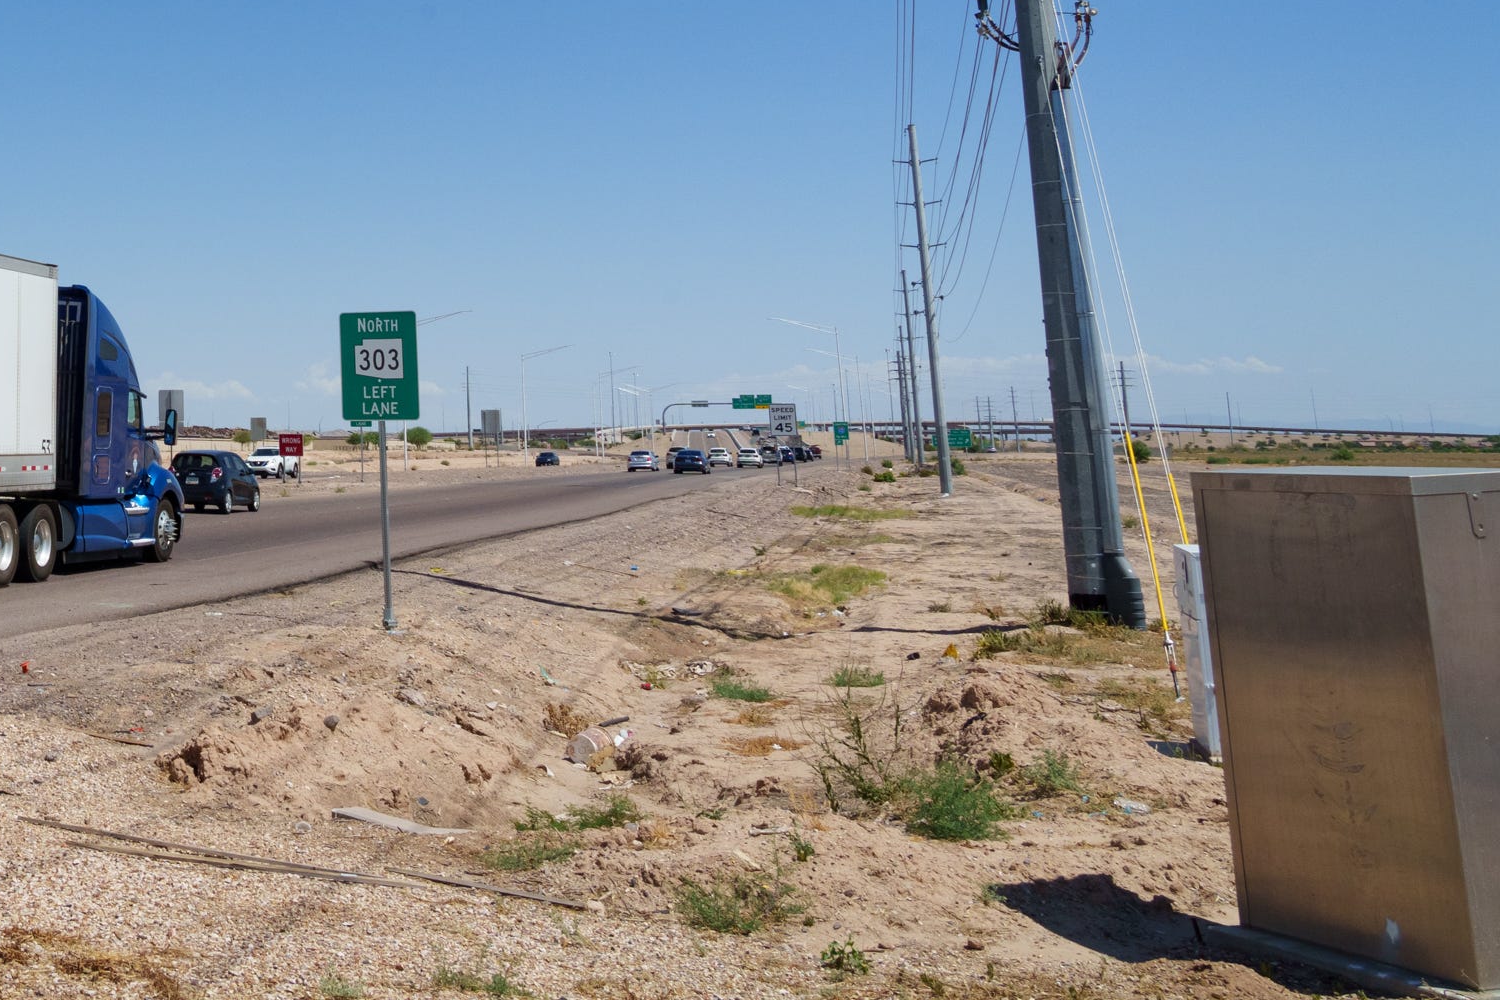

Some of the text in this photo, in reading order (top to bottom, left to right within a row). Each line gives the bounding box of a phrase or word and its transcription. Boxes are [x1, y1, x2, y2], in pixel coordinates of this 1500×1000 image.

[357, 317, 398, 332] NORTH
[359, 349, 399, 370] 303
[363, 386, 396, 398] LEFT
[362, 402, 399, 414] LANE
[775, 422, 793, 433] 45
